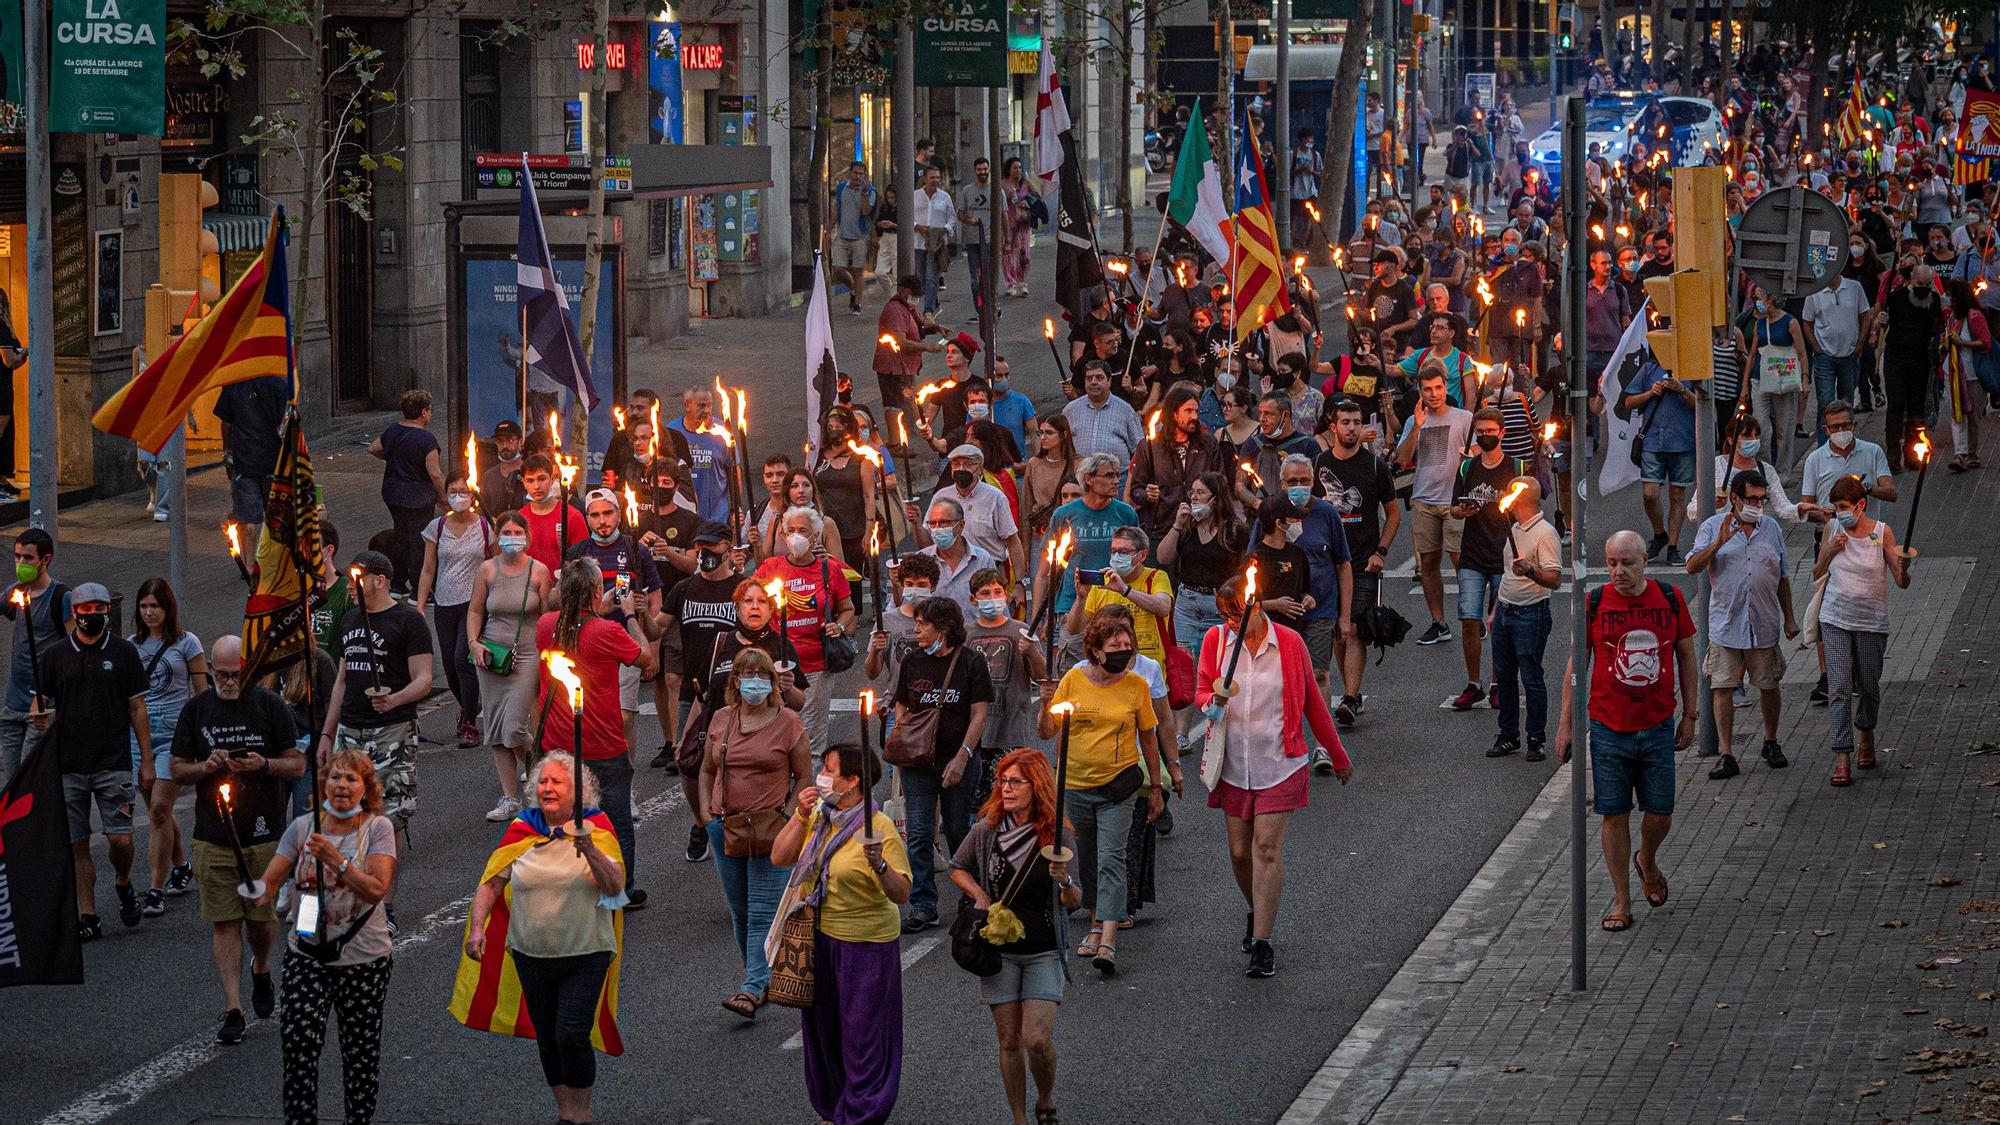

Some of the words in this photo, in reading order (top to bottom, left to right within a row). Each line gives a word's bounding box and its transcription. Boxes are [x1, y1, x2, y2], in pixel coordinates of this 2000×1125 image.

[85, 0, 121, 20] LA
[923, 18, 1001, 33] CURSA
[57, 22, 157, 45] CURSA
[697, 45, 724, 69] L'ARC
[75, 58, 97, 67] CURSA
[97, 59, 107, 67] DE
[107, 59, 117, 67] LA
[74, 67, 82, 75] 19
[82, 67, 92, 75] DE
[91, 67, 129, 76] SETEMBRE
[605, 158, 615, 166] 16
[616, 157, 632, 167] V19
[478, 172, 494, 181] H16
[549, 171, 591, 182] Companys
[605, 169, 615, 177] 20
[616, 169, 631, 177] B25
[542, 180, 568, 188] Triomf
[494, 285, 518, 293] NINGU
[494, 294, 505, 302] TU
[505, 294, 518, 302] SIS
[691, 455, 713, 464] TUR
[681, 599, 737, 622] ANTIFEIXISTA
